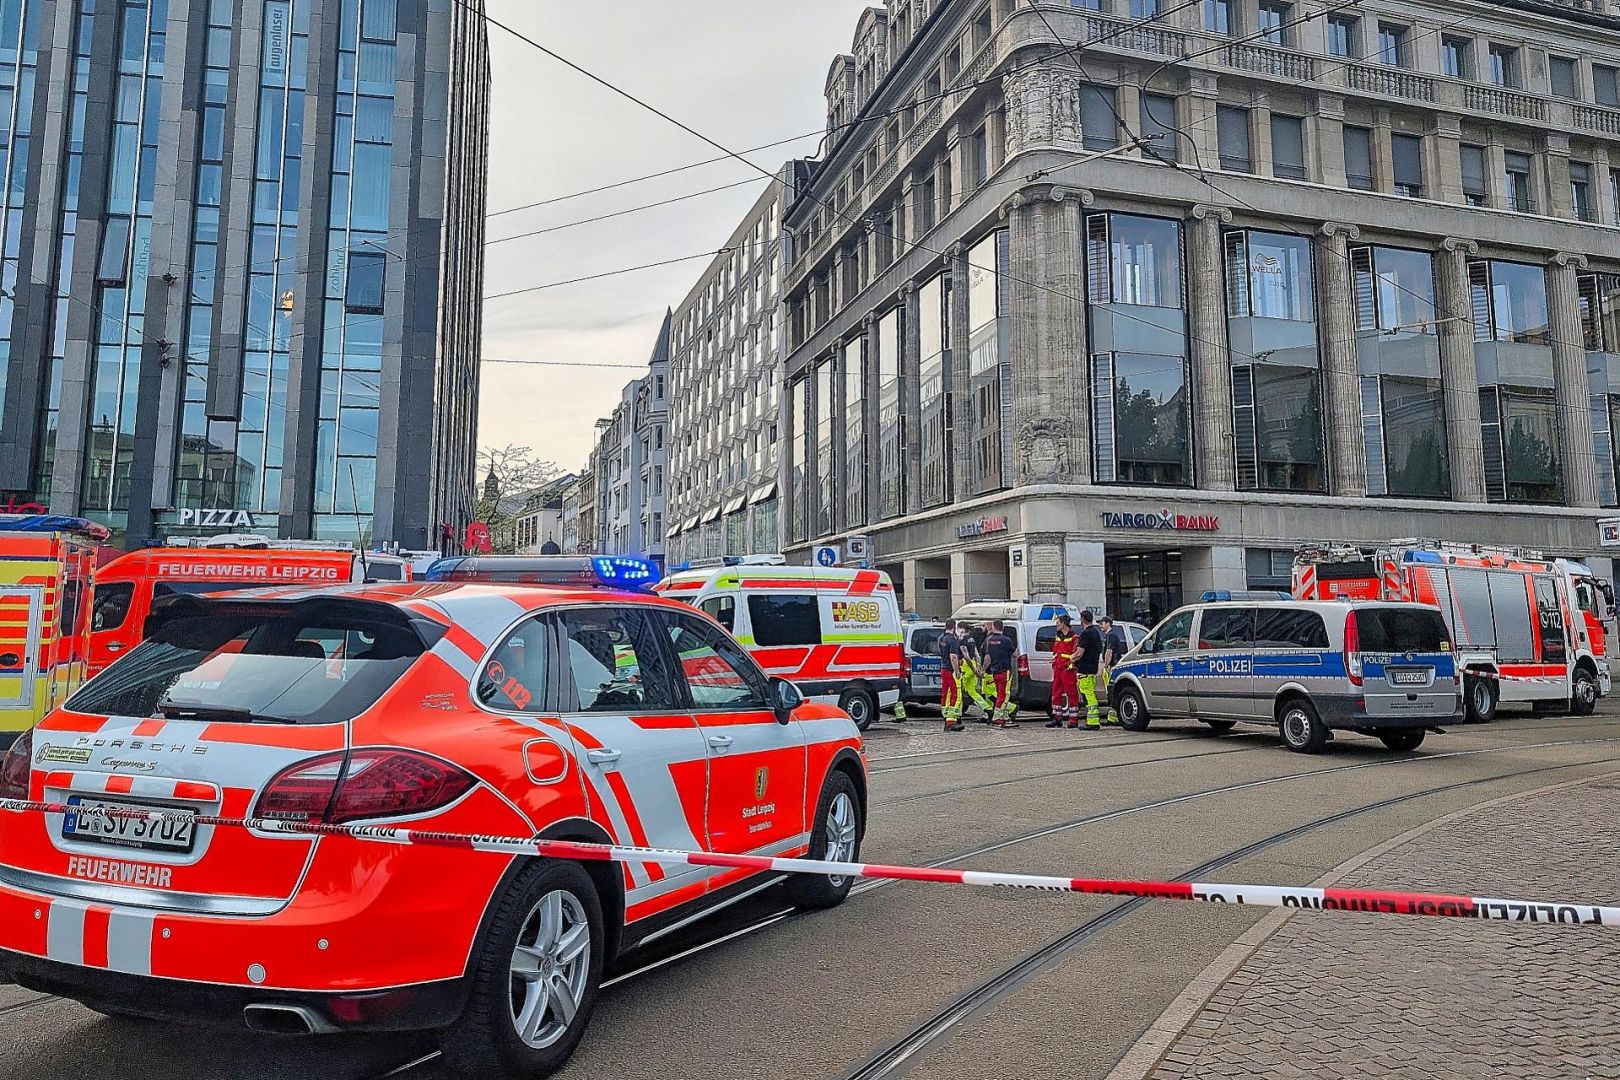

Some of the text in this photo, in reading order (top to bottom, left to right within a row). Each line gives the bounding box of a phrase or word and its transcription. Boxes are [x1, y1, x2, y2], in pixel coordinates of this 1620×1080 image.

[271, 8, 283, 67] augenlaser
[1252, 264, 1282, 275] WELLA
[178, 507, 252, 527] PIZZA
[158, 563, 338, 579] FEUERWEHR LEIPZIG
[845, 601, 881, 622] ASB
[1548, 612, 1562, 629] 112
[1209, 659, 1252, 673] POLIZEI
[1364, 656, 1392, 665] POLIZEI
[501, 676, 533, 710] 112
[76, 738, 208, 755] PORSCHE
[101, 756, 146, 770] Cayenne
[742, 802, 776, 819] Stadt Leipzig
[67, 856, 172, 888] FEUERWEHR
